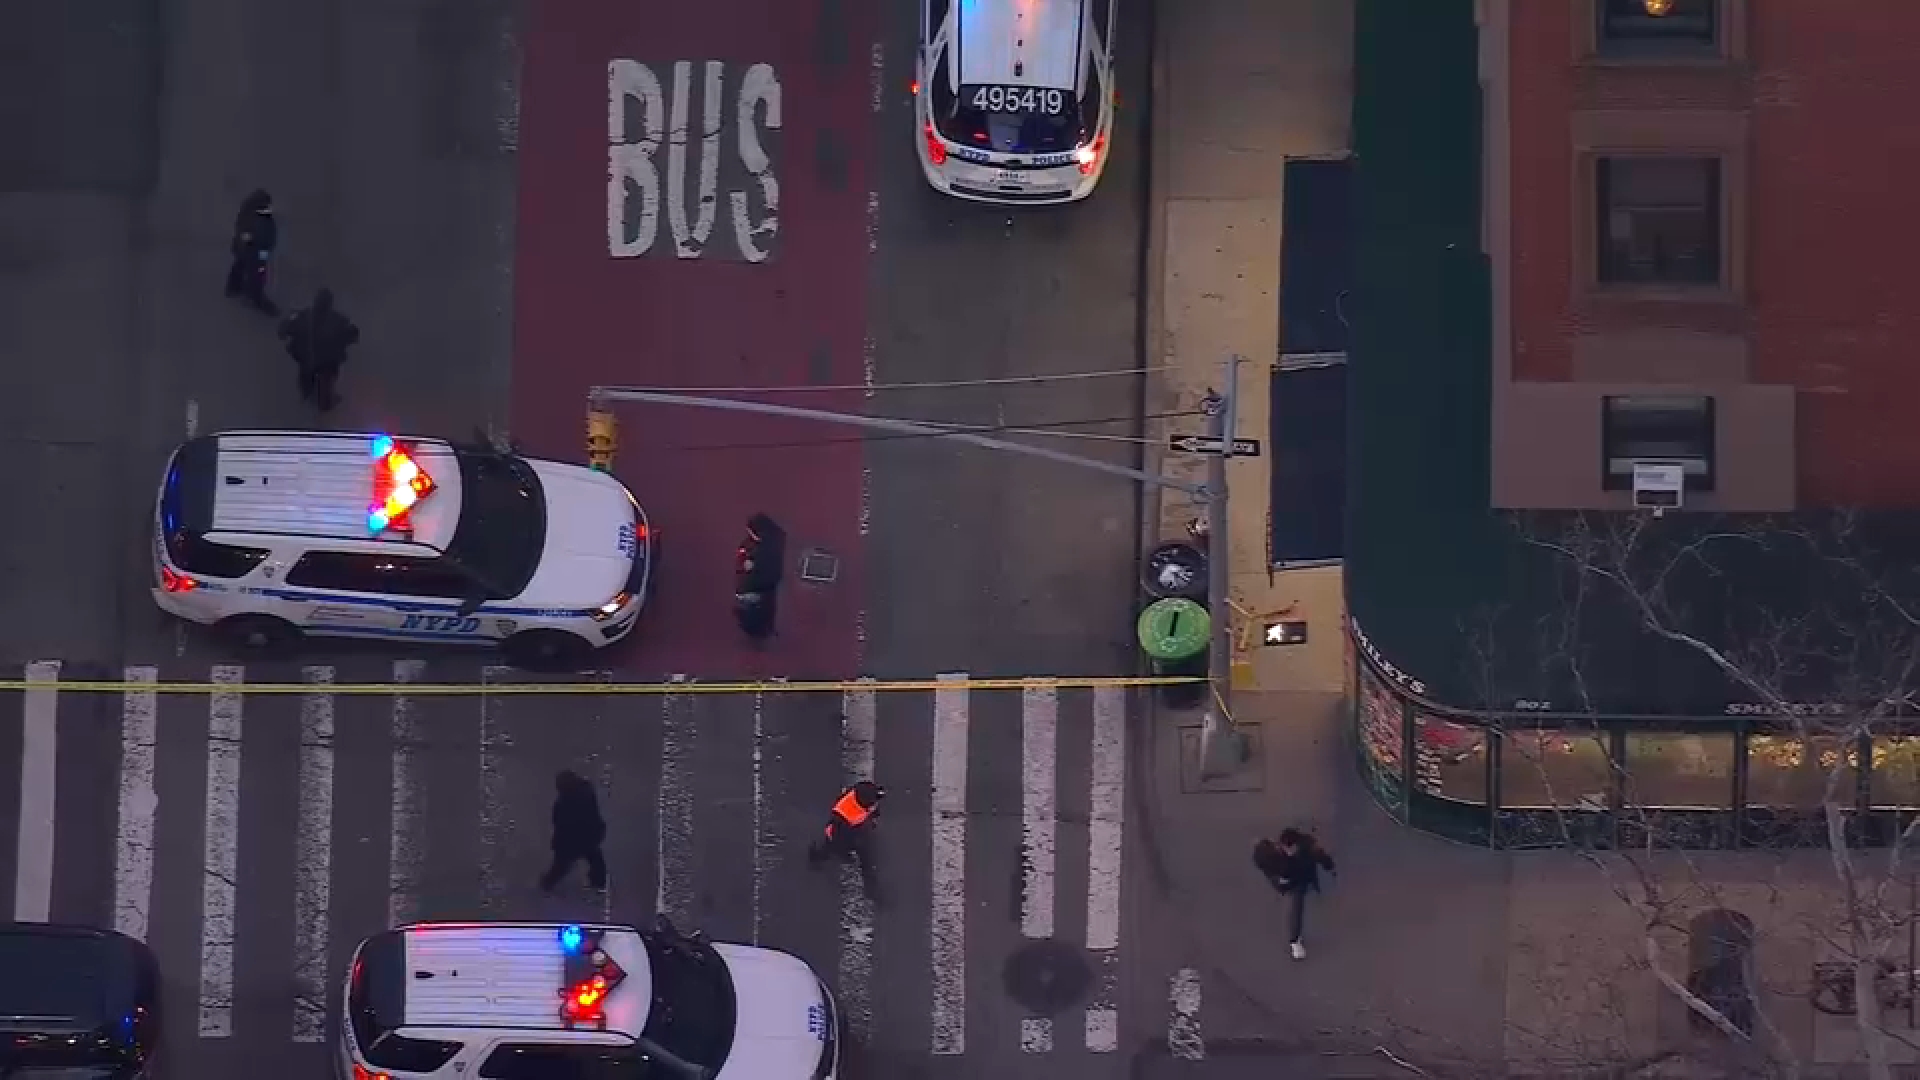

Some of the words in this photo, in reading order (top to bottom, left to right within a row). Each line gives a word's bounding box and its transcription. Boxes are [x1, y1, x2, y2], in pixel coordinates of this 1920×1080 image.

[972, 86, 1063, 114] 495419
[607, 59, 782, 263] BUS
[400, 614, 481, 632] NYPD
